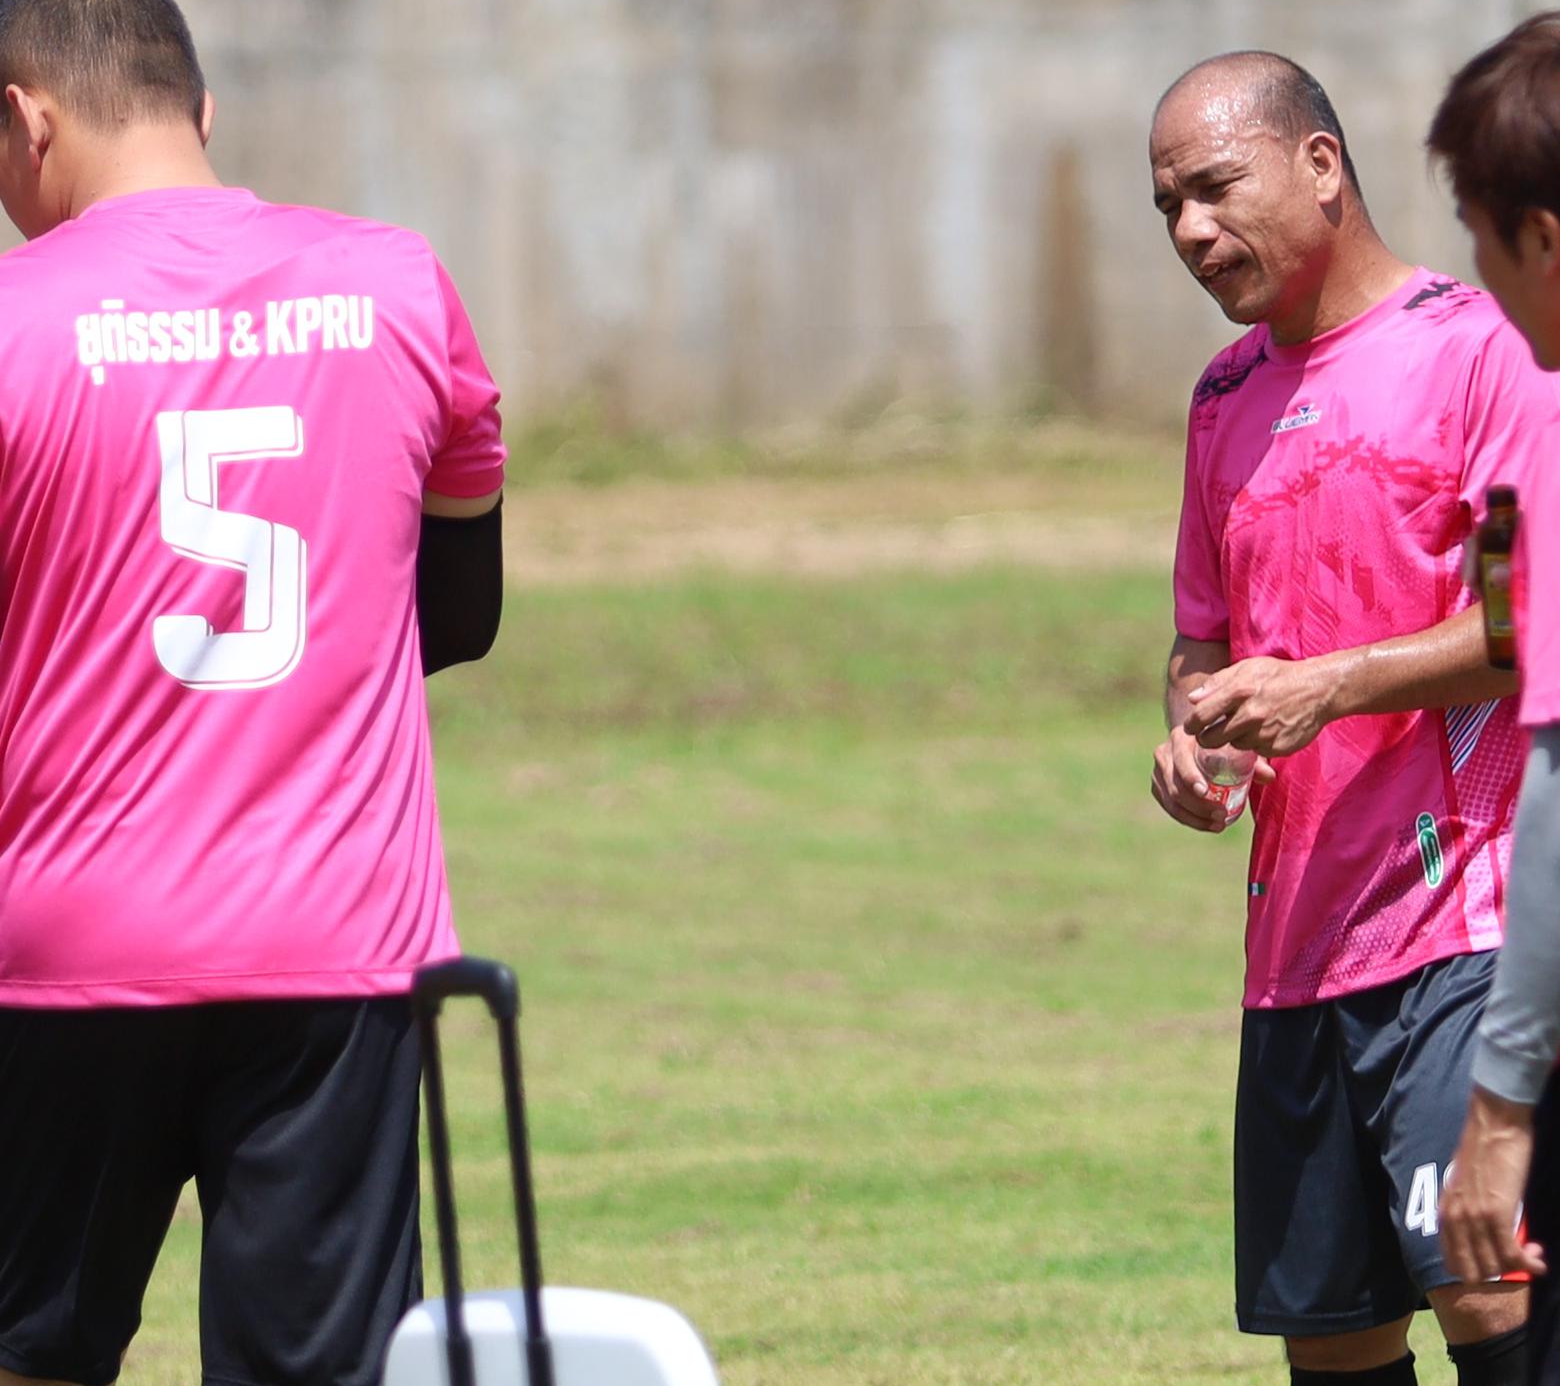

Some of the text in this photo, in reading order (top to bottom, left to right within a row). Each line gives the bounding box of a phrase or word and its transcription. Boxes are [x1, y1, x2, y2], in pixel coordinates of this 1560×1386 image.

[228, 310, 261, 358] &
[265, 294, 374, 356] KPRU
[152, 405, 308, 692] 5
[1404, 1159, 1458, 1237] 4
